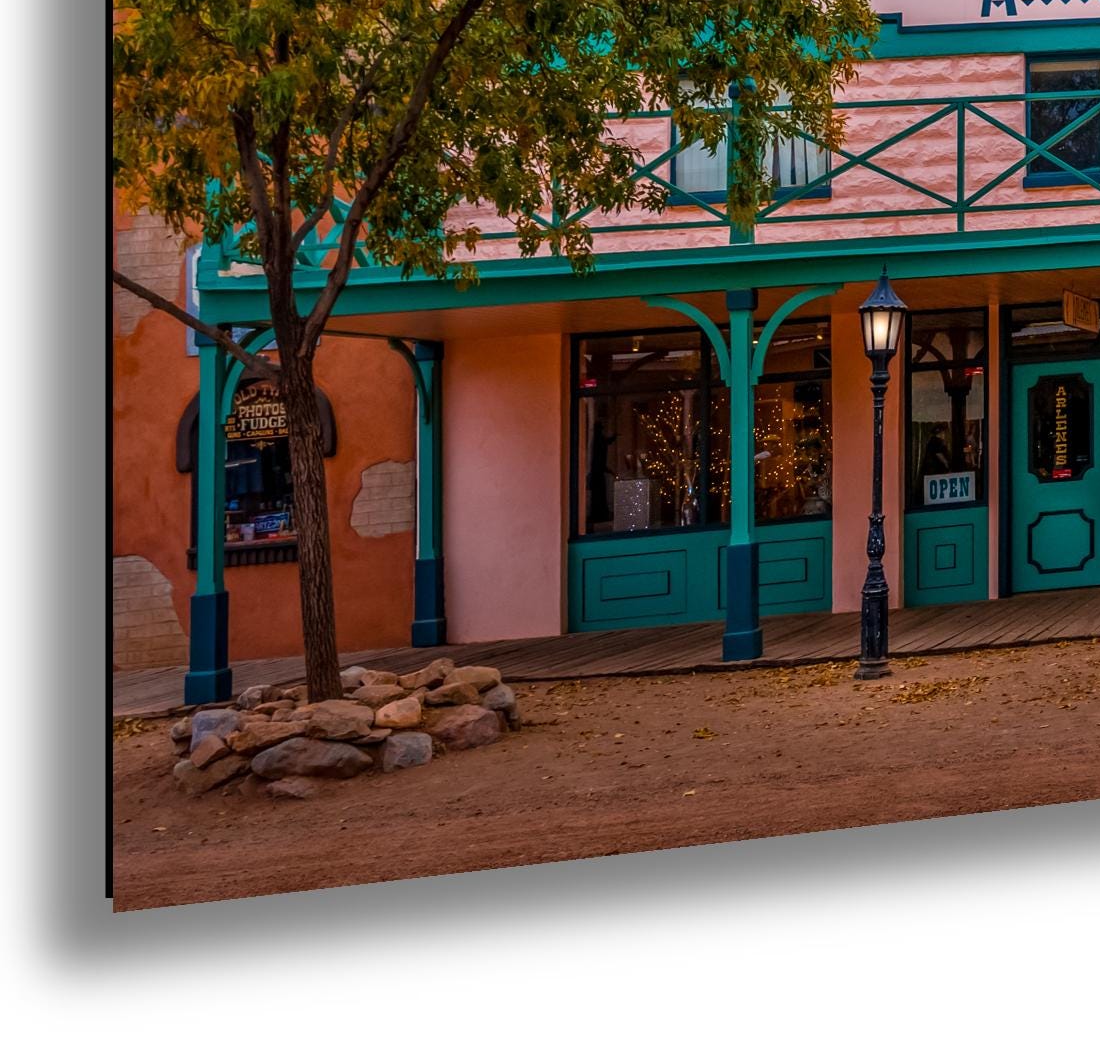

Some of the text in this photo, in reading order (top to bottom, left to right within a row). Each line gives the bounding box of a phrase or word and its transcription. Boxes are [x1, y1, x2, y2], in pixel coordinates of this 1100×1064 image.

[234, 387, 257, 405] OLD
[238, 402, 287, 418] PHOTOS
[240, 415, 287, 431] FUDGE
[1055, 386, 1068, 466] ARLENES
[929, 476, 970, 500] OPEN
